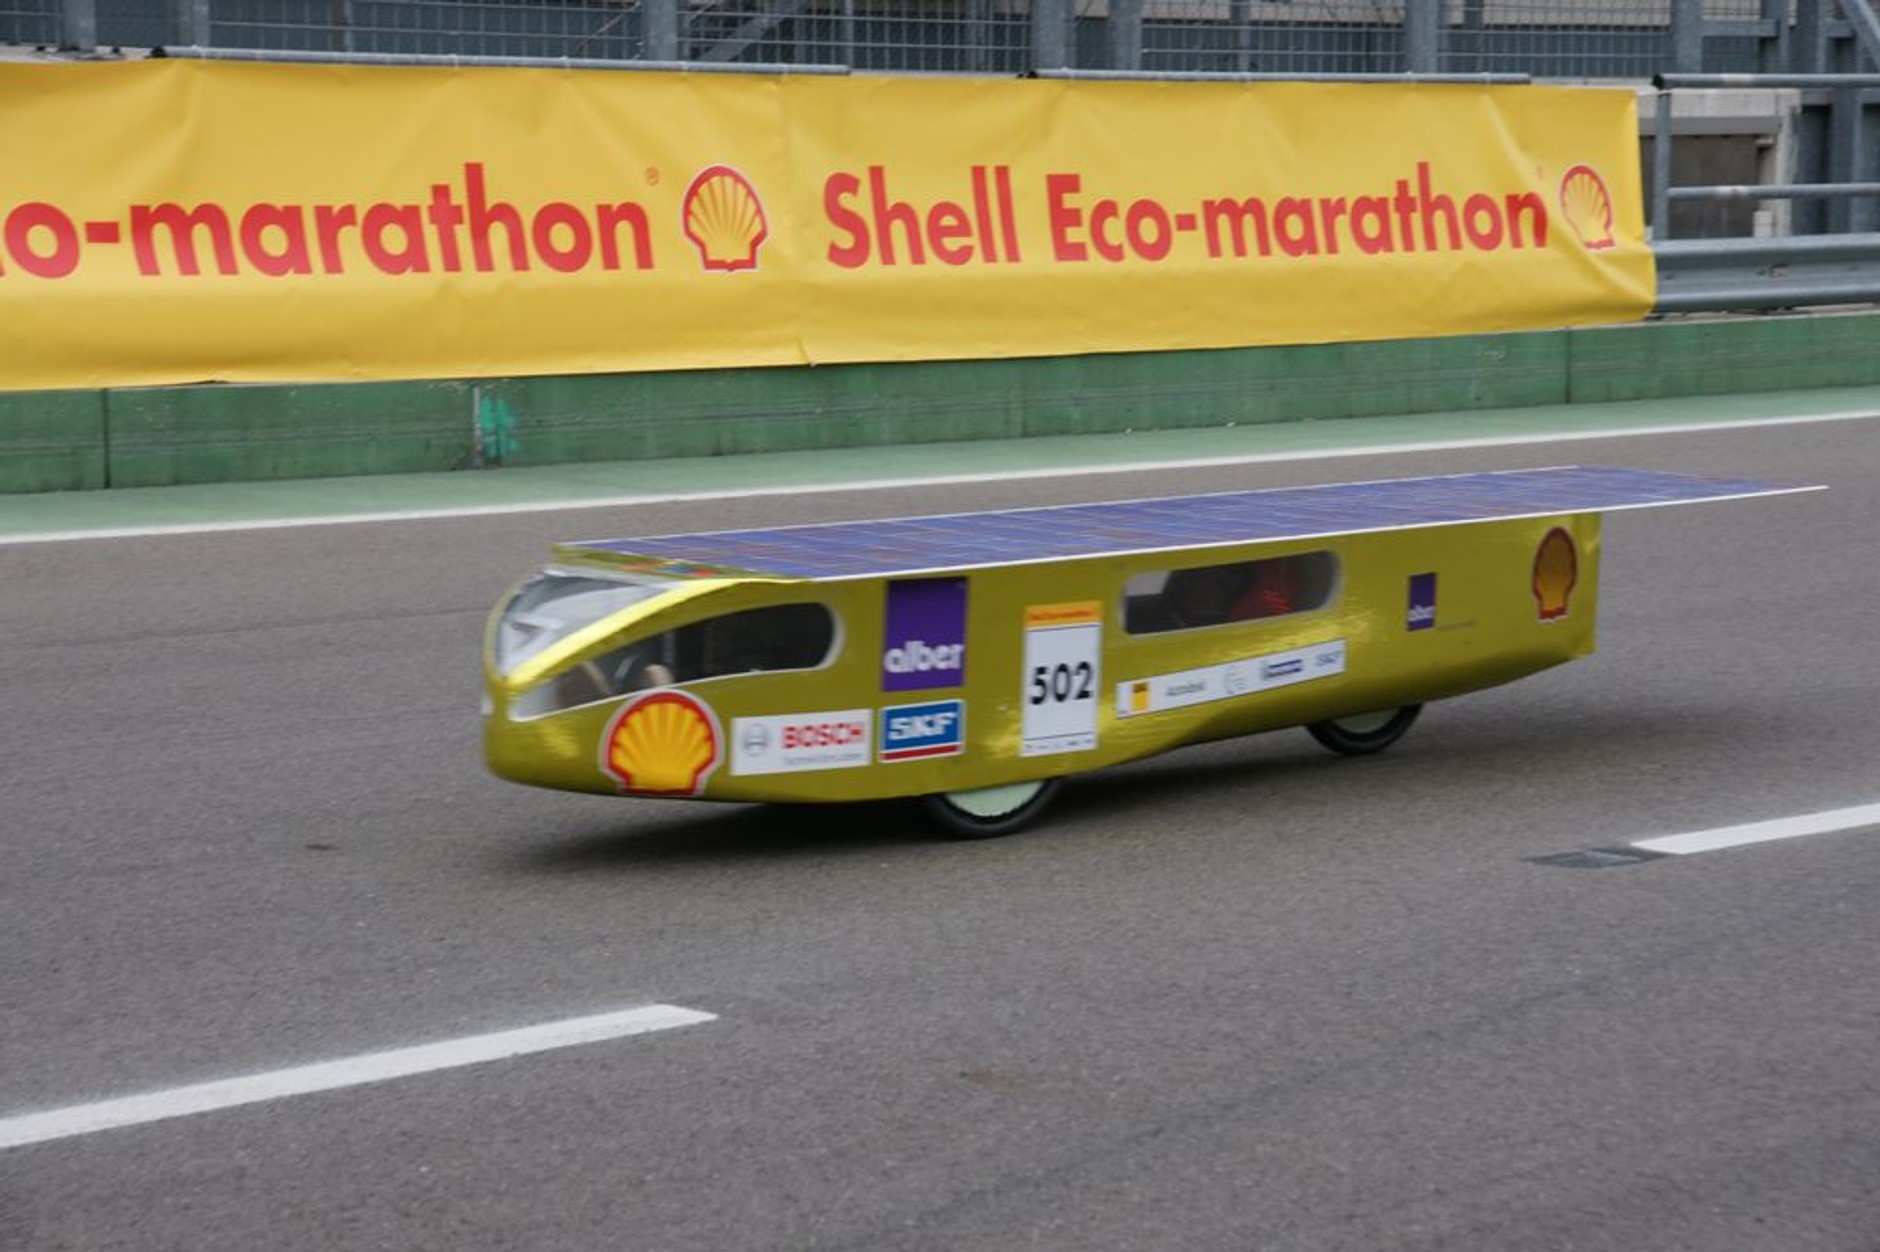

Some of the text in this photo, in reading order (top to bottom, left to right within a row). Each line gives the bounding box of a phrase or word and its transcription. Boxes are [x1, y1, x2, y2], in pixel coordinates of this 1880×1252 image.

[0, 162, 654, 278] o-marathon
[823, 161, 1548, 268] Shell Eco-marathon
[883, 640, 964, 673] alber
[1029, 661, 1093, 705] 502
[782, 722, 866, 748] BOSCH
[888, 712, 957, 740] SKF
